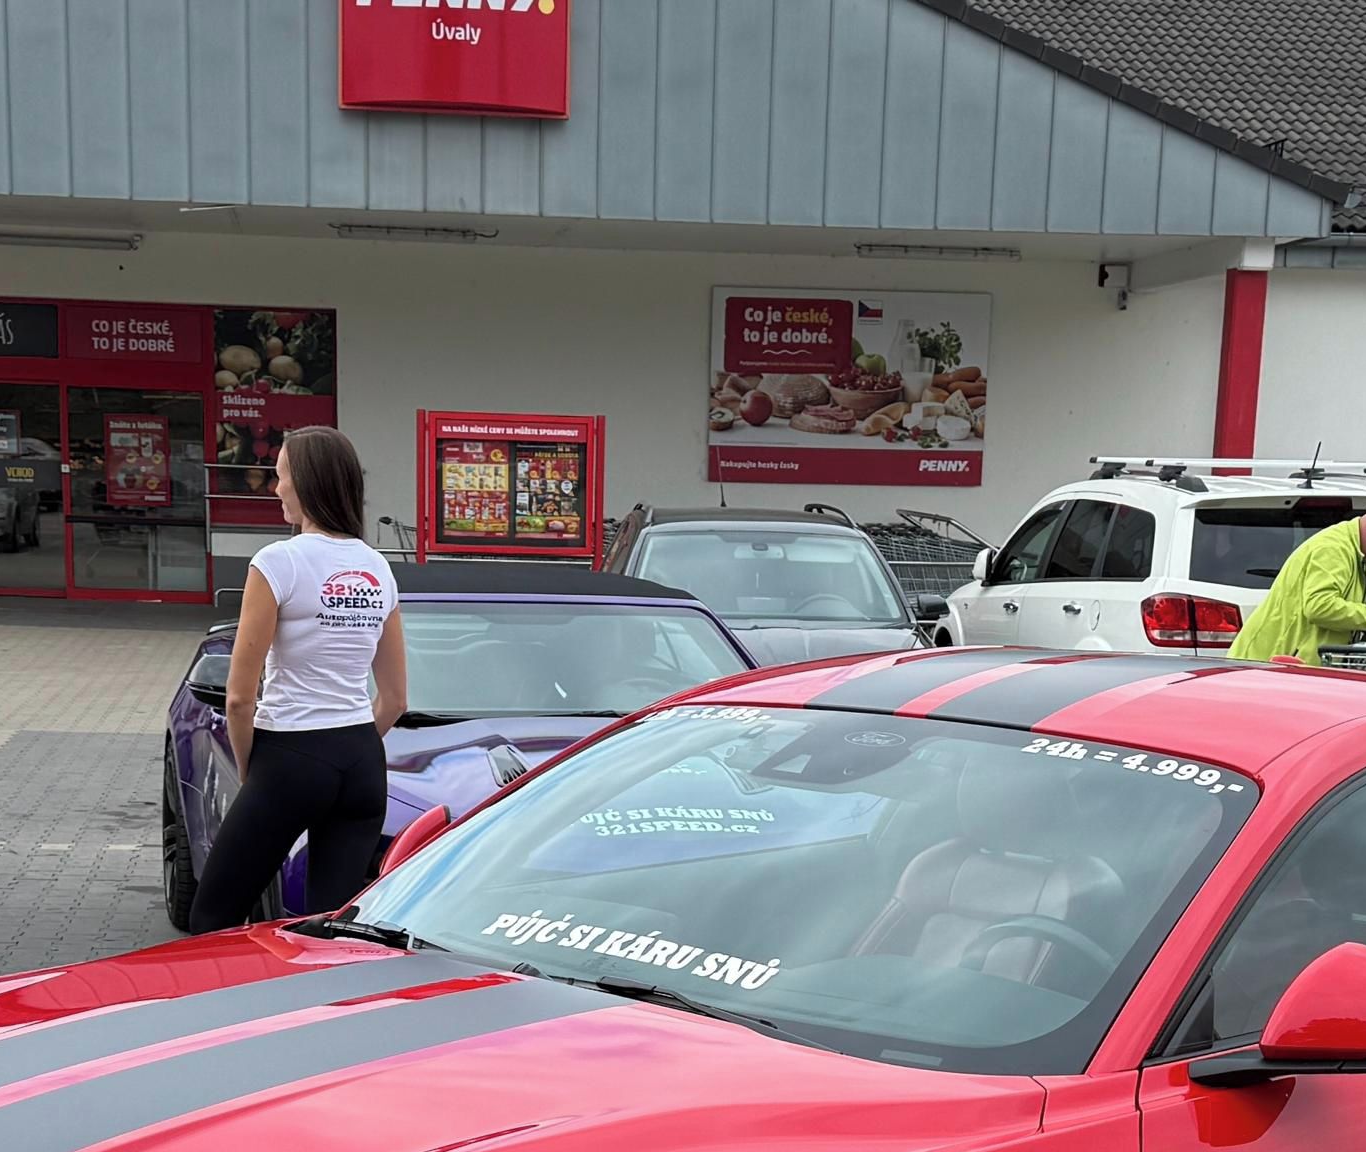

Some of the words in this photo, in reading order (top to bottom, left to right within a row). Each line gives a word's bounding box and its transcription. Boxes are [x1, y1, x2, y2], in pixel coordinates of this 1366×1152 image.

[431, 18, 481, 45] Úvaly
[744, 307, 764, 322] Co
[766, 305, 782, 325] je
[785, 306, 833, 326] české,
[91, 319, 110, 333] CO
[112, 320, 126, 336] JE
[128, 318, 174, 336] ČESKÉ,
[743, 327, 761, 342] to
[762, 326, 778, 345] je
[781, 327, 833, 344] dobré.
[91, 336, 110, 350] TO
[112, 337, 126, 352] JE
[128, 336, 175, 353] DOBRÉ
[222, 394, 266, 407] Sklizeno
[222, 408, 241, 419] pro
[919, 459, 970, 472] PENNY.
[322, 583, 353, 596] 321
[1021, 737, 1088, 760] 24h
[1093, 750, 1119, 763] =
[1121, 753, 1244, 795] 4.999,-
[626, 807, 654, 819] SI
[654, 805, 724, 820] KÁRU
[727, 808, 776, 822] SNŮ
[481, 909, 576, 946] PŮJČ
[561, 924, 607, 950] SI
[593, 930, 705, 970] KÁRU
[691, 952, 782, 990] SNŮ
